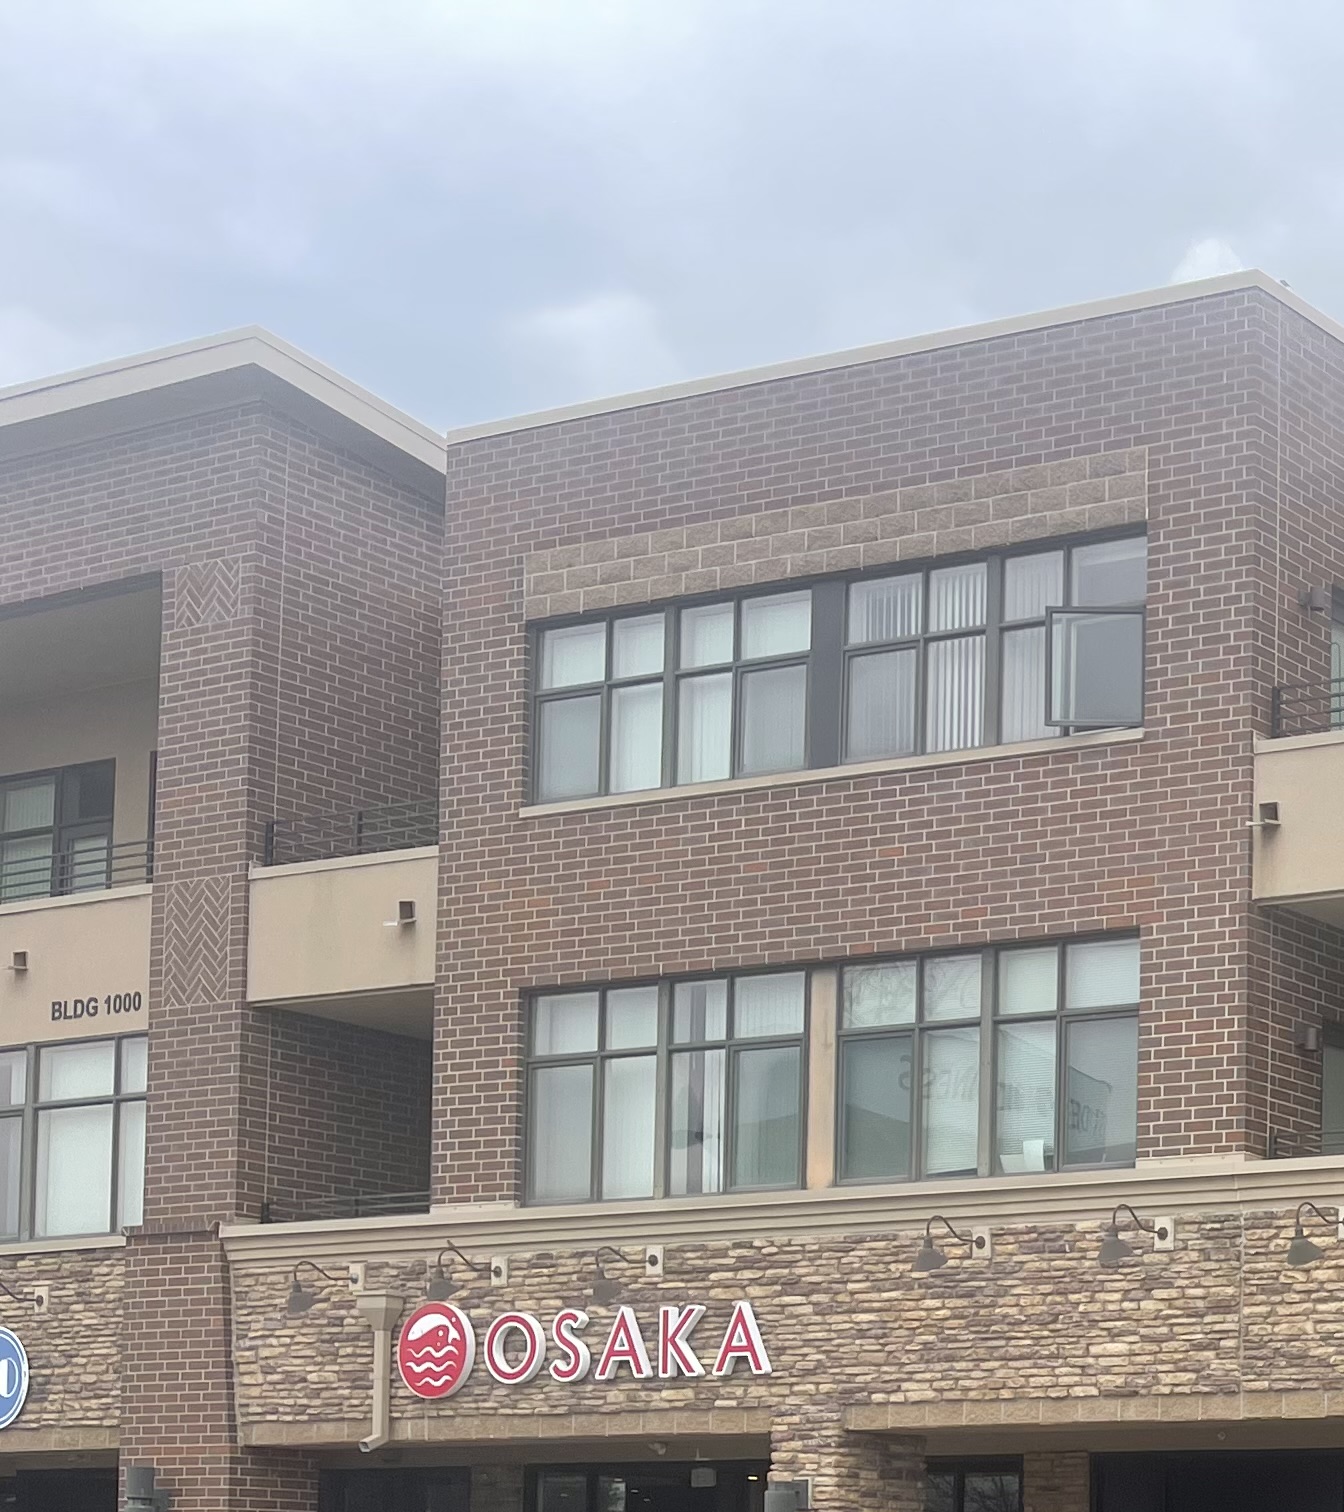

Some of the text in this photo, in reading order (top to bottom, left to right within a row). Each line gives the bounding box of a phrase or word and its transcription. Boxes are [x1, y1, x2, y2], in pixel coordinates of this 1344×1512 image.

[51, 991, 142, 1021] BLDG 1000
[483, 1300, 773, 1385] OSAKA
